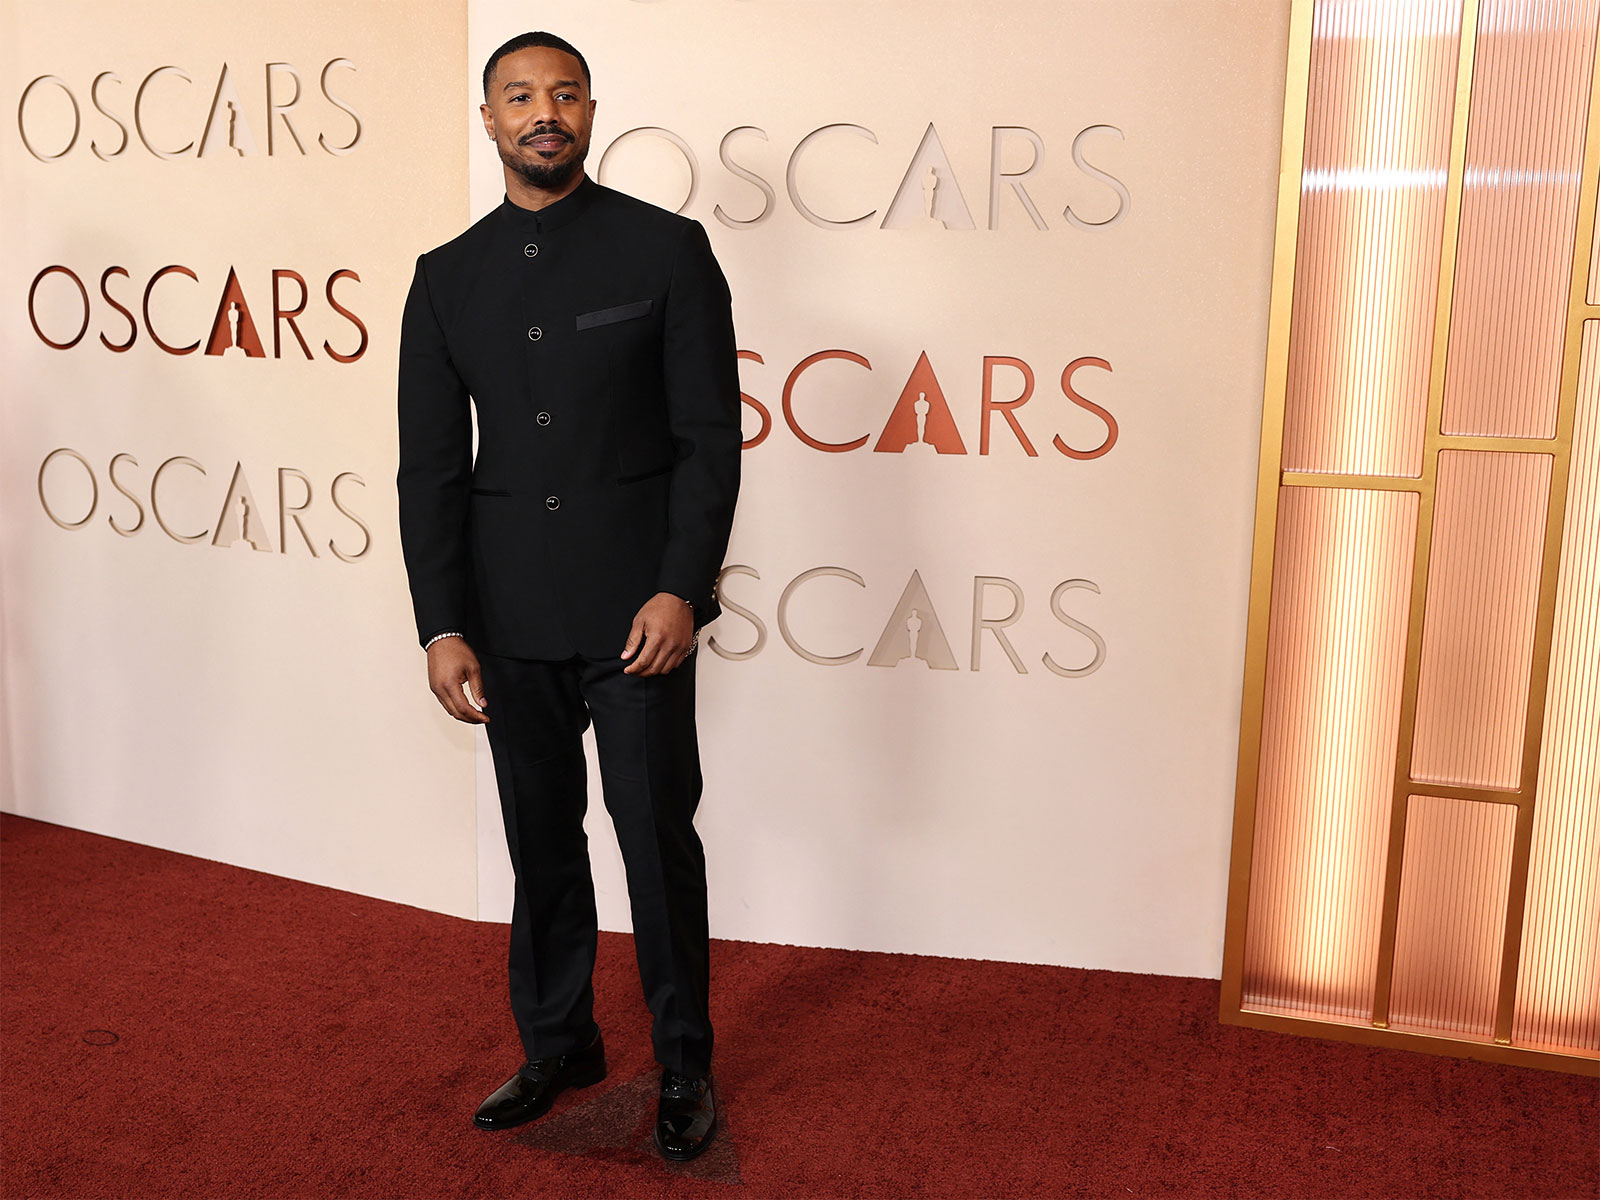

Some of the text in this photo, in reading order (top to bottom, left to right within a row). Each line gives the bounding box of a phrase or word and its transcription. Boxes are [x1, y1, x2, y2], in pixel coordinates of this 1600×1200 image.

[18, 58, 362, 163] OSCARS
[597, 121, 1131, 231] OSCARS
[28, 265, 369, 364] OSCARS
[737, 349, 1119, 460] SCARS
[38, 448, 373, 564] OSCARS
[707, 564, 1107, 678] SCARS
